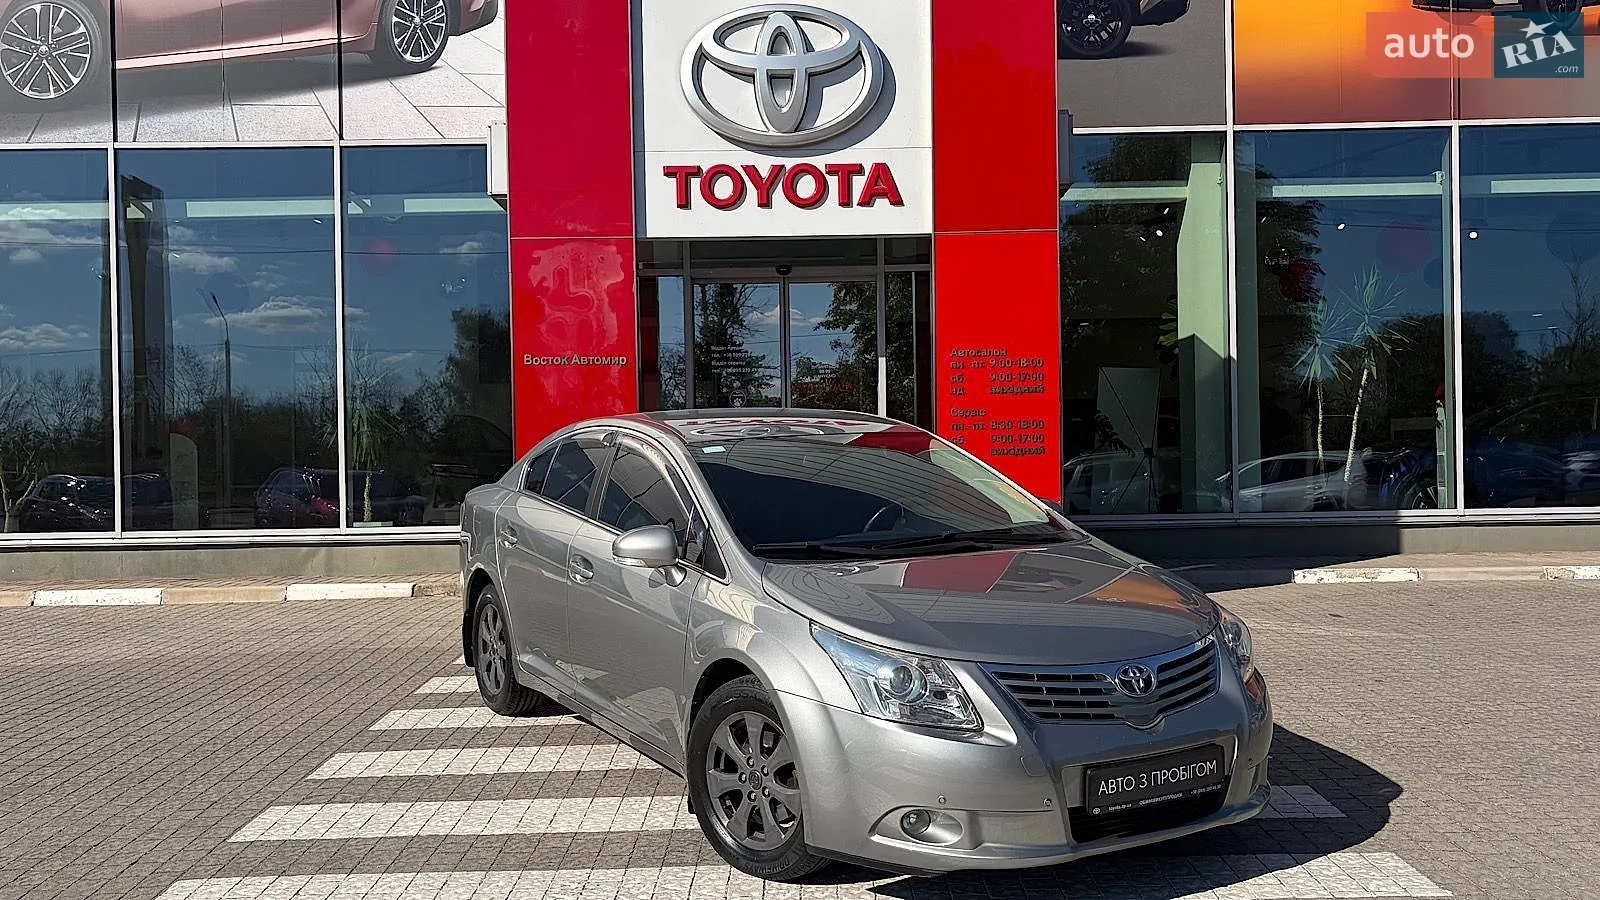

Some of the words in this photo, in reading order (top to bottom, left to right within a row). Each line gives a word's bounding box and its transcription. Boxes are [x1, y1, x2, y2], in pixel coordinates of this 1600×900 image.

[663, 162, 905, 211] TOYOTA
[523, 354, 568, 365] Восток
[571, 354, 627, 367] Автомир
[950, 347, 1007, 357] Автосалон
[1098, 776, 1135, 796] АВТО
[1151, 760, 1217, 786] ПРОБІГОМ
